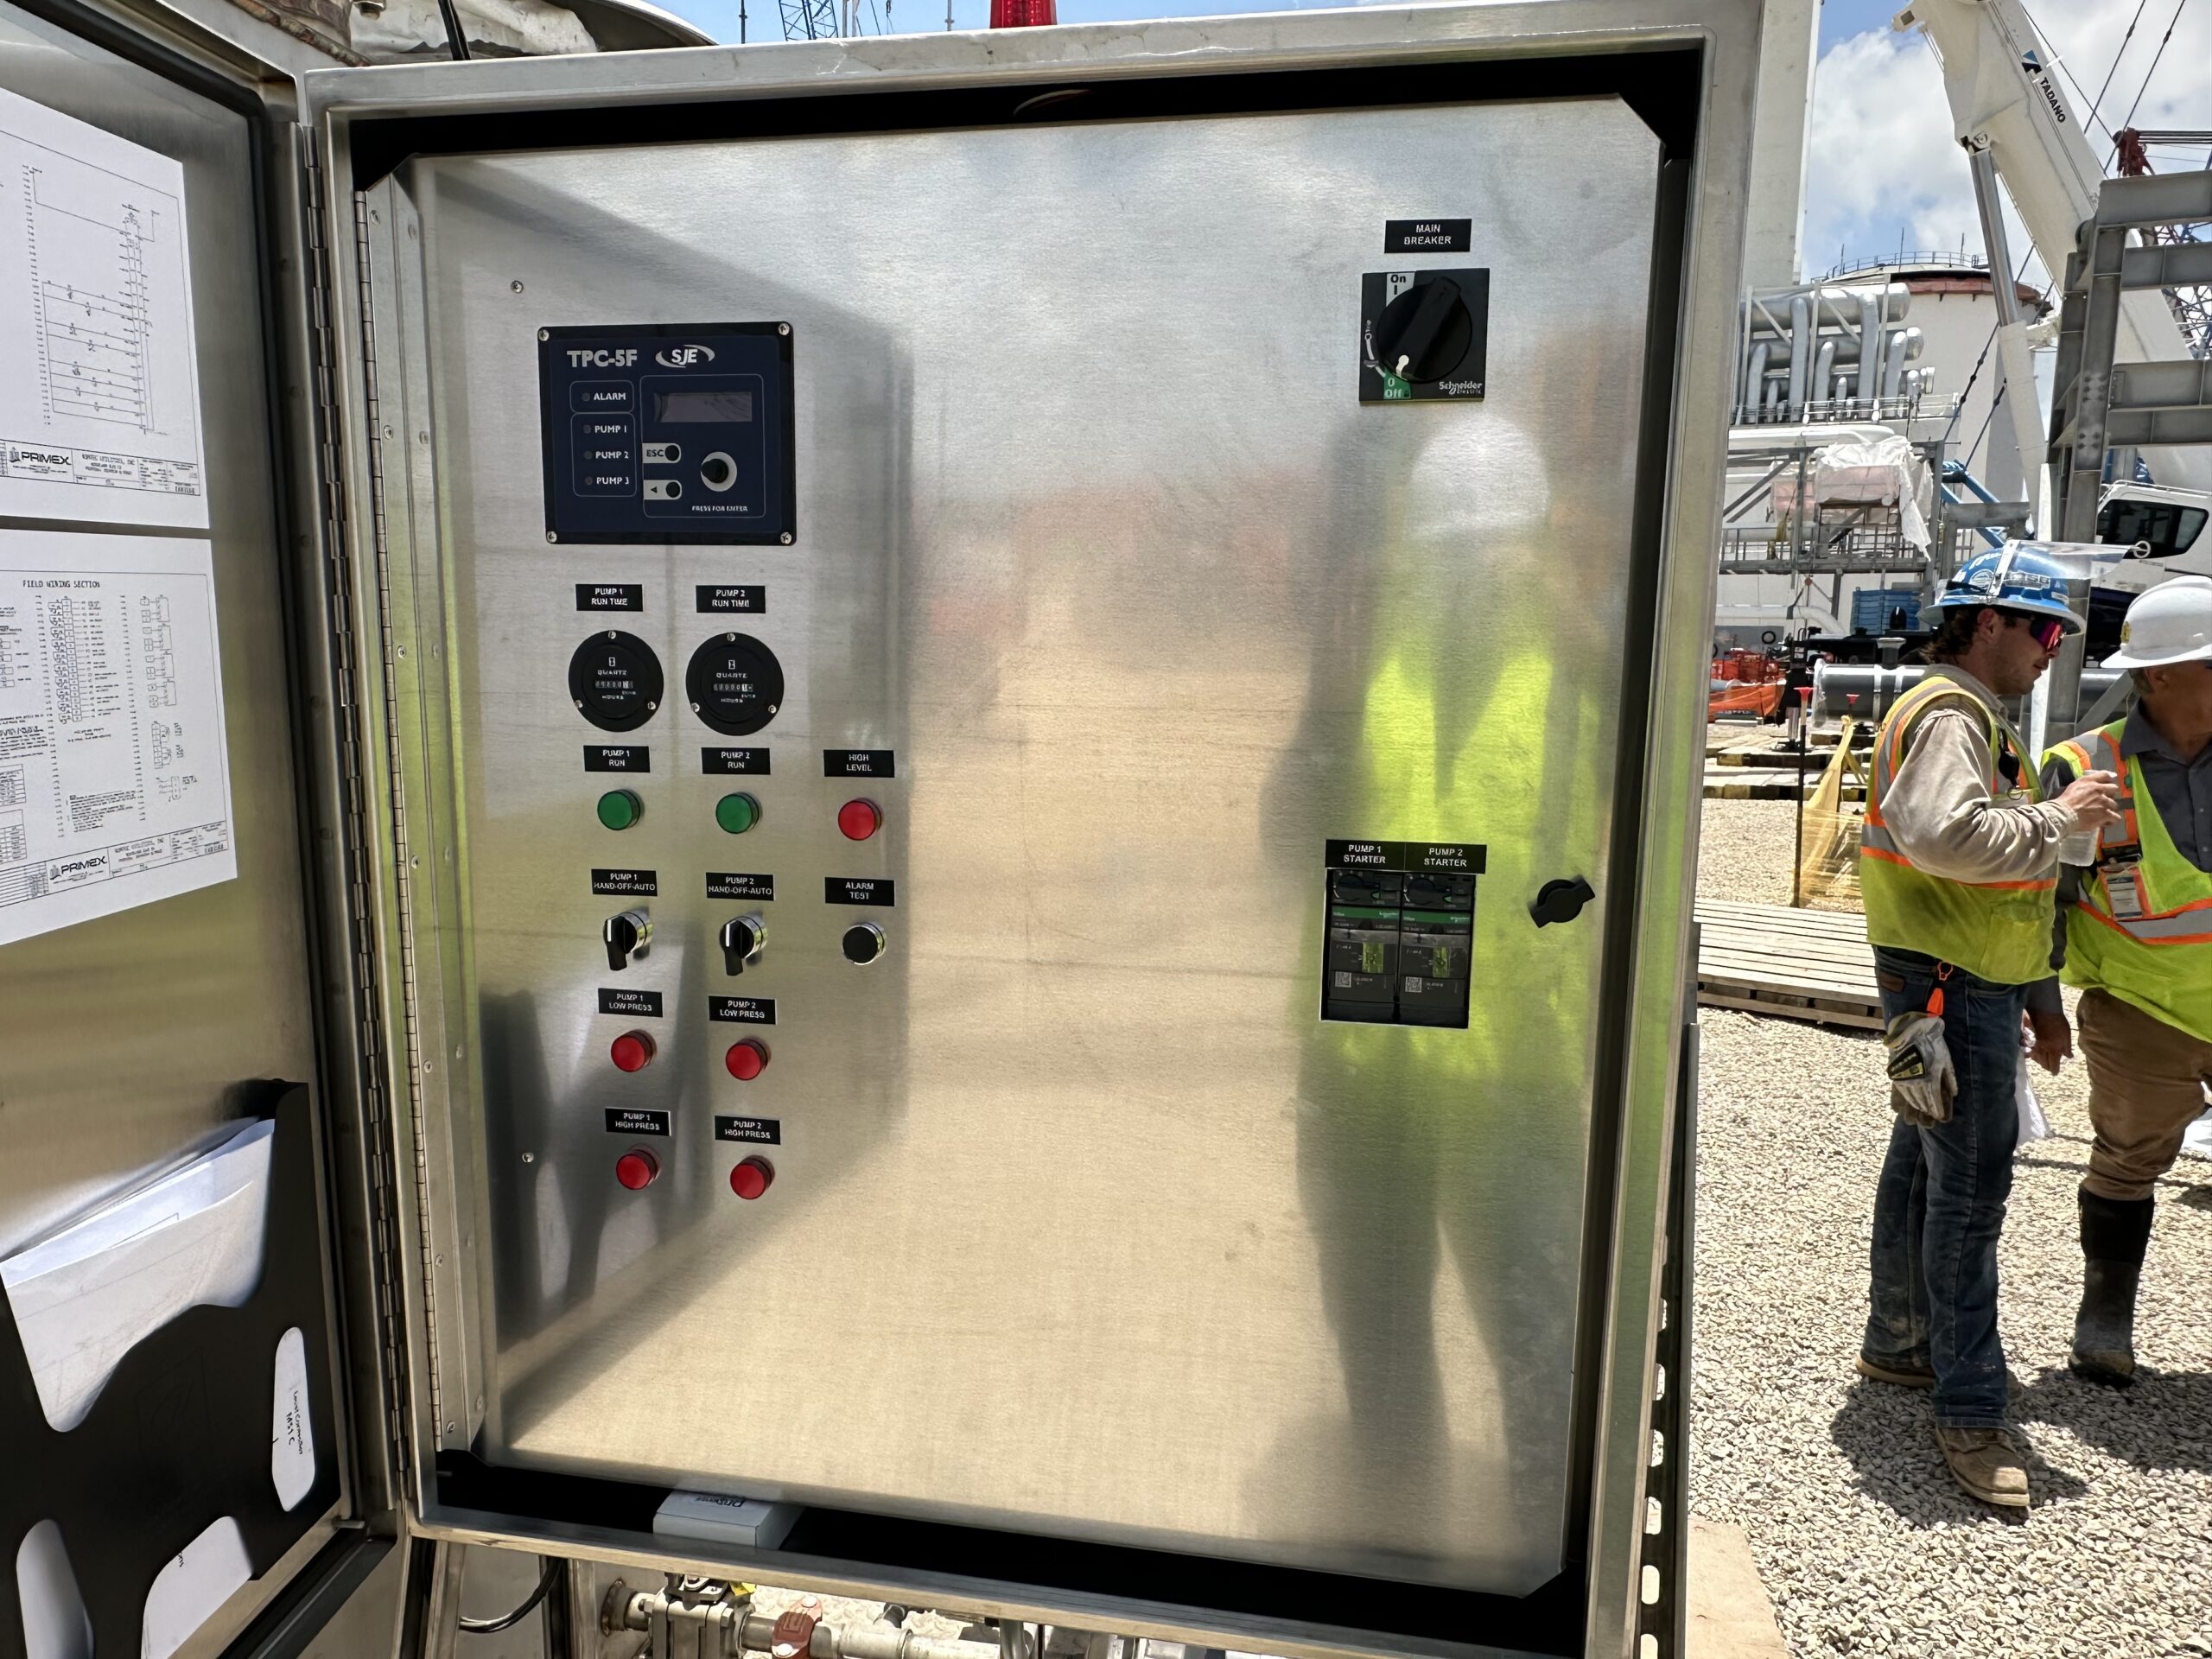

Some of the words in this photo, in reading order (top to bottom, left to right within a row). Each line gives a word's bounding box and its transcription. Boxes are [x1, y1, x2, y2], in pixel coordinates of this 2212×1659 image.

[2040, 76, 2067, 124] TADANO
[1415, 224, 1441, 233] MAIN
[1403, 235, 1452, 245] BREAKER
[1389, 274, 1407, 283] On
[566, 348, 638, 368] TPC-5F
[671, 347, 698, 365] SJE
[1439, 380, 1483, 395] Schneider
[593, 392, 626, 401] ALARM
[1383, 388, 1403, 399] Off
[594, 424, 621, 434] PUMP
[595, 450, 622, 460] PUMP
[645, 448, 664, 458] ESC
[21, 450, 72, 466] PRIMEX
[596, 476, 623, 485] PUMP
[22, 580, 44, 588] FIELD
[73, 580, 101, 588] SECTION
[715, 588, 740, 597] PUMP
[591, 597, 608, 606] RUN
[609, 597, 628, 606] TIME
[711, 599, 729, 607] RUN
[730, 599, 750, 607] TIME
[849, 753, 869, 762] HIGH
[608, 759, 626, 767] RUN
[728, 760, 745, 769] RUN
[846, 763, 873, 772] LEVEL
[1348, 844, 1375, 853] PUMP
[1428, 847, 1456, 855] PUMP
[1343, 854, 1386, 864] STARTER
[1423, 857, 1467, 868] STARTER
[60, 855, 108, 874] PRIMEX
[725, 876, 747, 885] PUMP
[594, 882, 656, 891] HAND-OFF-AUTO
[708, 885, 772, 895] HAND-OFF-AUTO
[845, 881, 874, 890] ALARM
[849, 891, 869, 899] TEST
[608, 1001, 626, 1010] LOW
[627, 1002, 652, 1012] PRESS
[728, 1000, 750, 1008] PUMP
[719, 1008, 738, 1017] LOW
[739, 1009, 766, 1019] PRESS
[623, 1112, 645, 1121] PUMP
[634, 1122, 660, 1131] PRESS
[733, 1120, 756, 1128] PUMP
[724, 1128, 744, 1137] HIGH
[745, 1129, 771, 1140] PRESS
